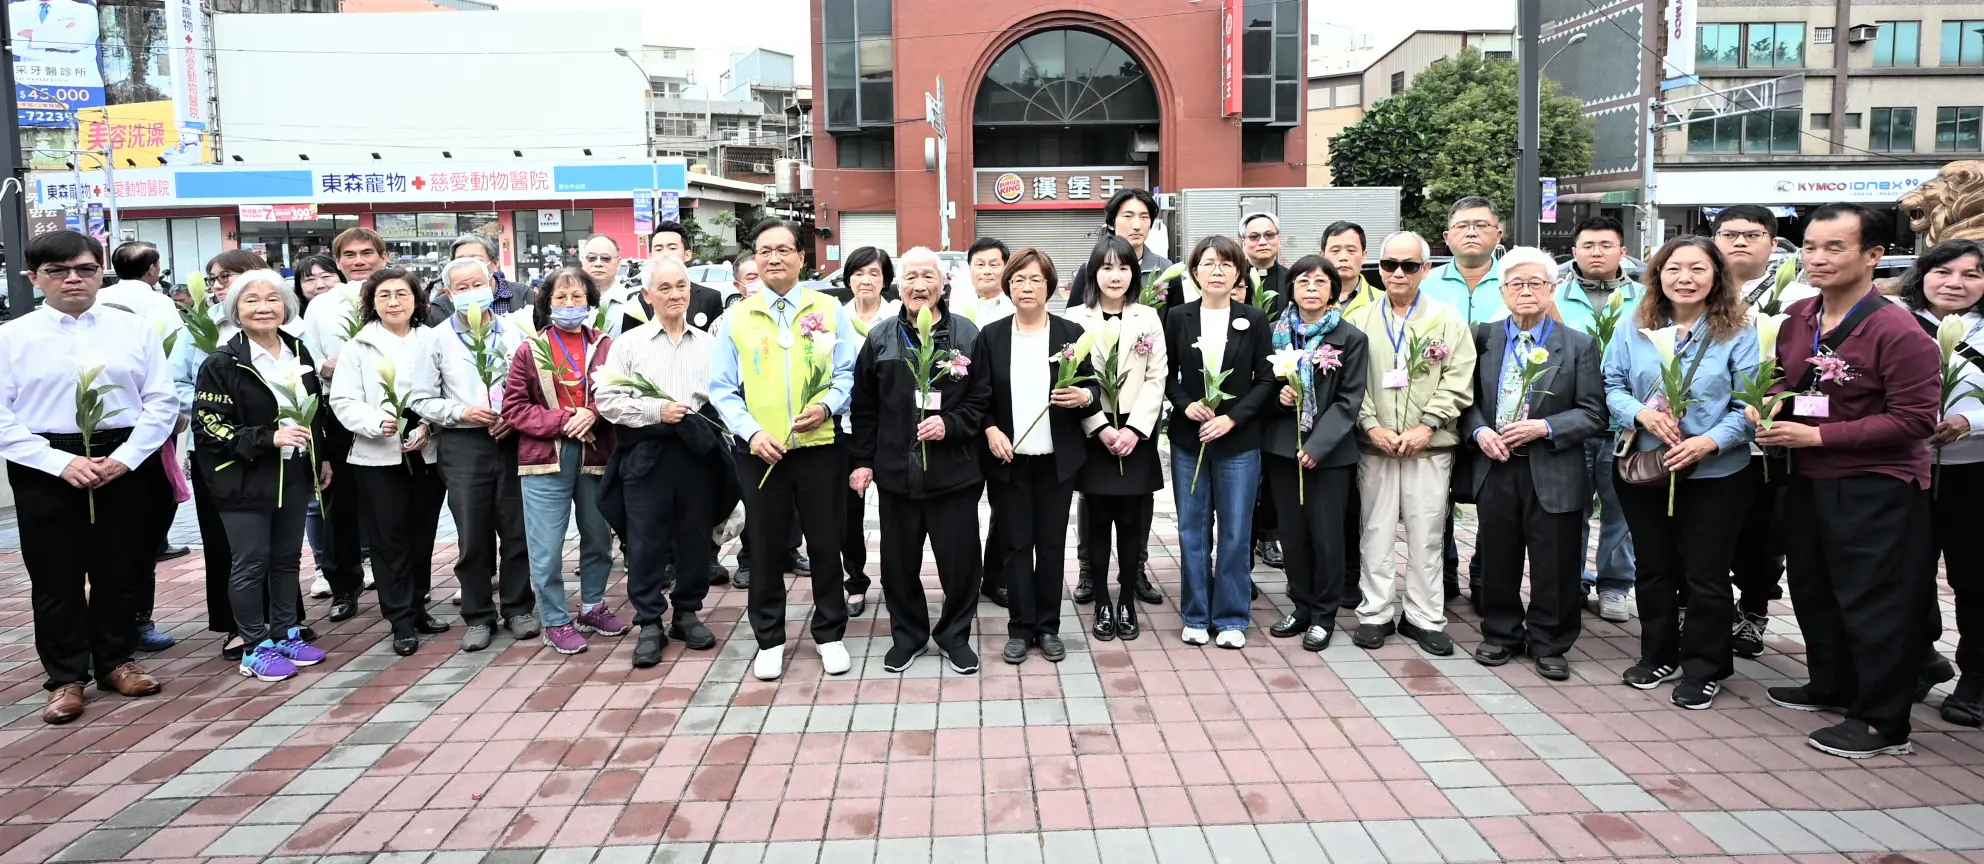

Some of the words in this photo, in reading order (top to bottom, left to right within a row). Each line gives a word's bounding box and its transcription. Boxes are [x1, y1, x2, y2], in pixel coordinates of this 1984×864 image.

[184, 46, 199, 119] 慈愛動物醫院
[87, 120, 165, 150] 美容洗澡
[321, 173, 407, 193] 東森寵物
[429, 170, 549, 192] 慈愛動物醫院
[1000, 179, 1020, 188] BURGER
[1000, 184, 1021, 194] KING
[1032, 175, 1124, 199] 漢堡王
[1797, 182, 1847, 191] KYMCO
